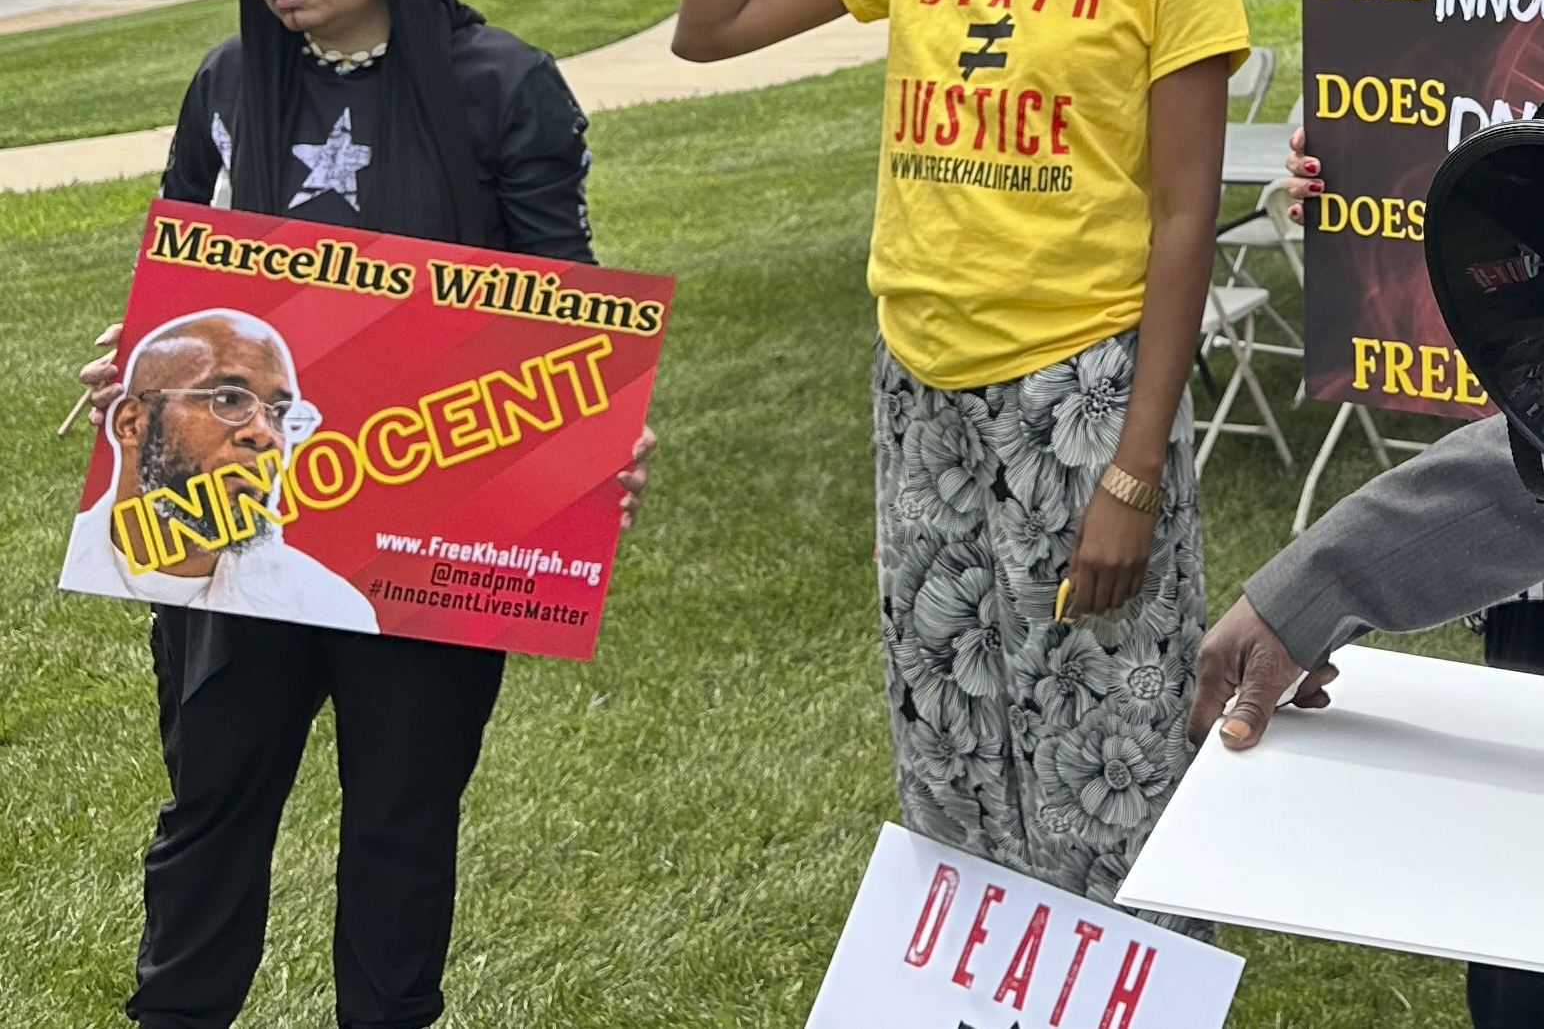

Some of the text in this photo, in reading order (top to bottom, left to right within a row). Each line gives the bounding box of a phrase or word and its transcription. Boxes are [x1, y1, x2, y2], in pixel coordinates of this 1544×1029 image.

[894, 79, 1073, 156] JUSTICE
[1315, 73, 1446, 128] DOES
[147, 216, 666, 336] Marcellus Williams
[111, 334, 614, 575] INNOCENT
[376, 532, 602, 586] www.FreeKhaliifah.org
[431, 561, 535, 596] @madpmo
[370, 579, 589, 626] #InnocentLivesMatter
[904, 862, 1157, 1029] DEATH
